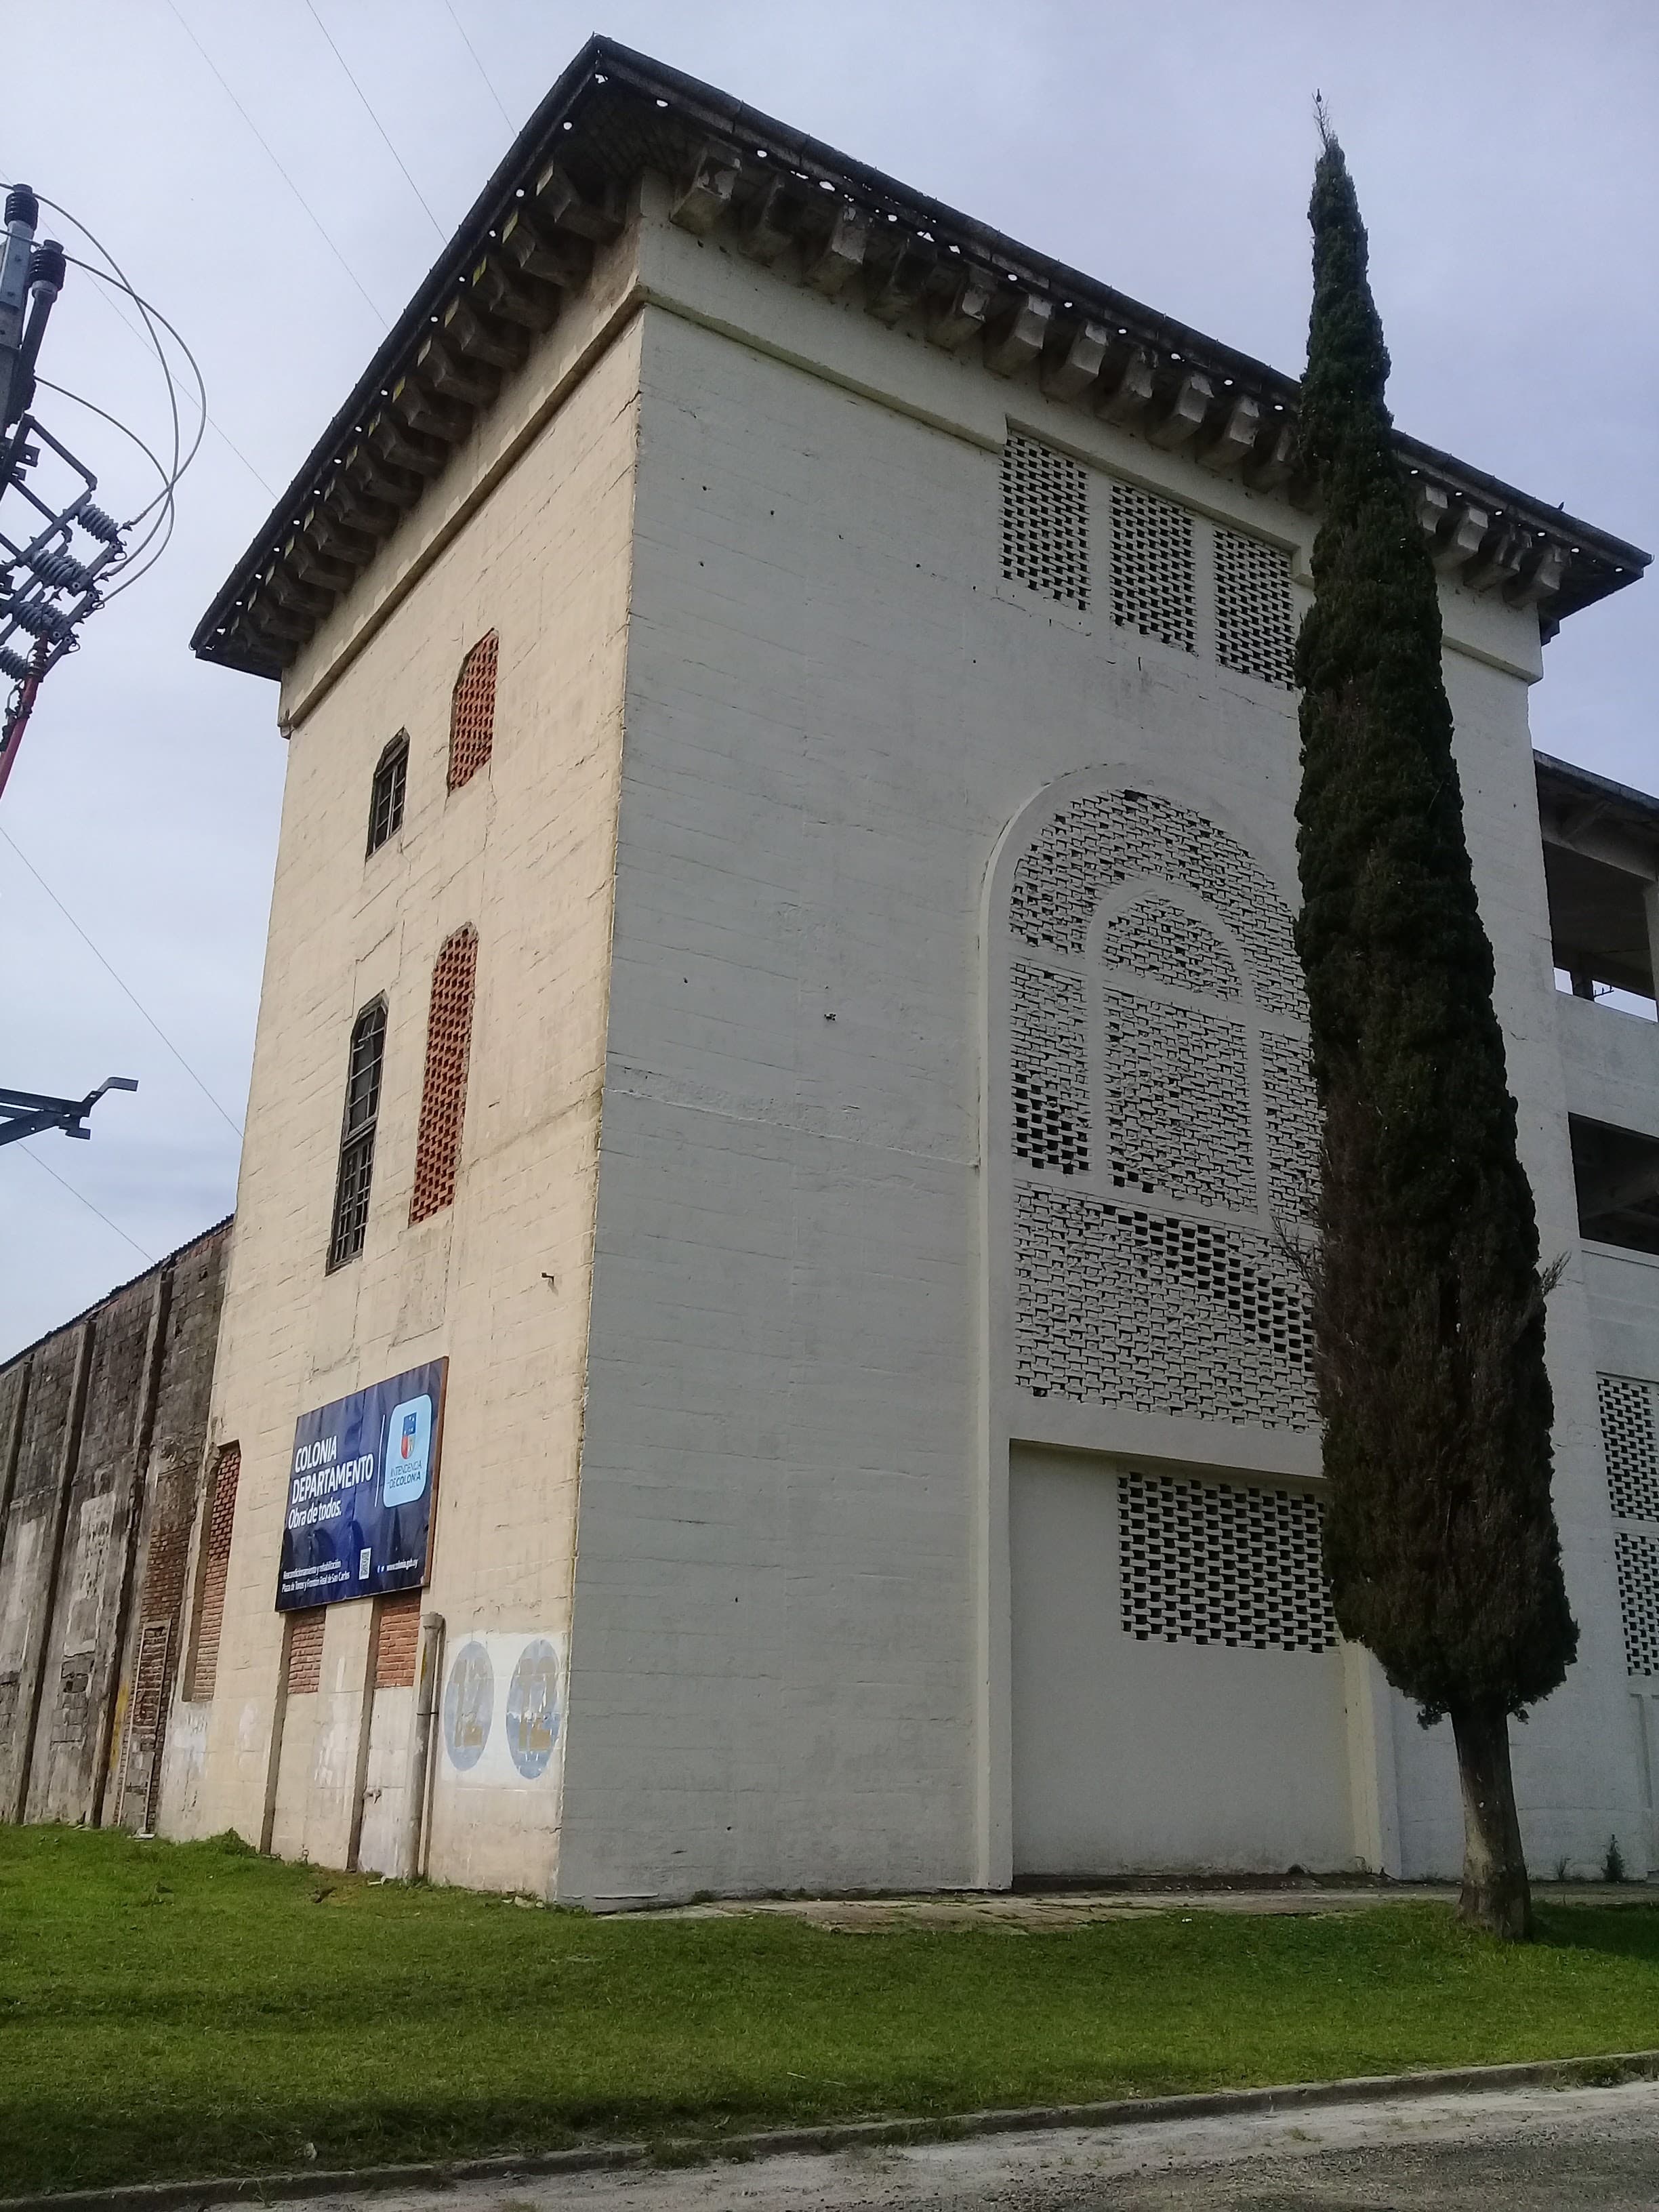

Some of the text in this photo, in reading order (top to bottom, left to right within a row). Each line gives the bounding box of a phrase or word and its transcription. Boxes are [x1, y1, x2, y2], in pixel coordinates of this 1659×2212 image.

[295, 1435, 337, 1473] COLONIA
[292, 1453, 373, 1504] DEPARTAMENTO
[396, 1471, 421, 1486] COLONIA
[288, 1496, 342, 1530] Obra de todos.
